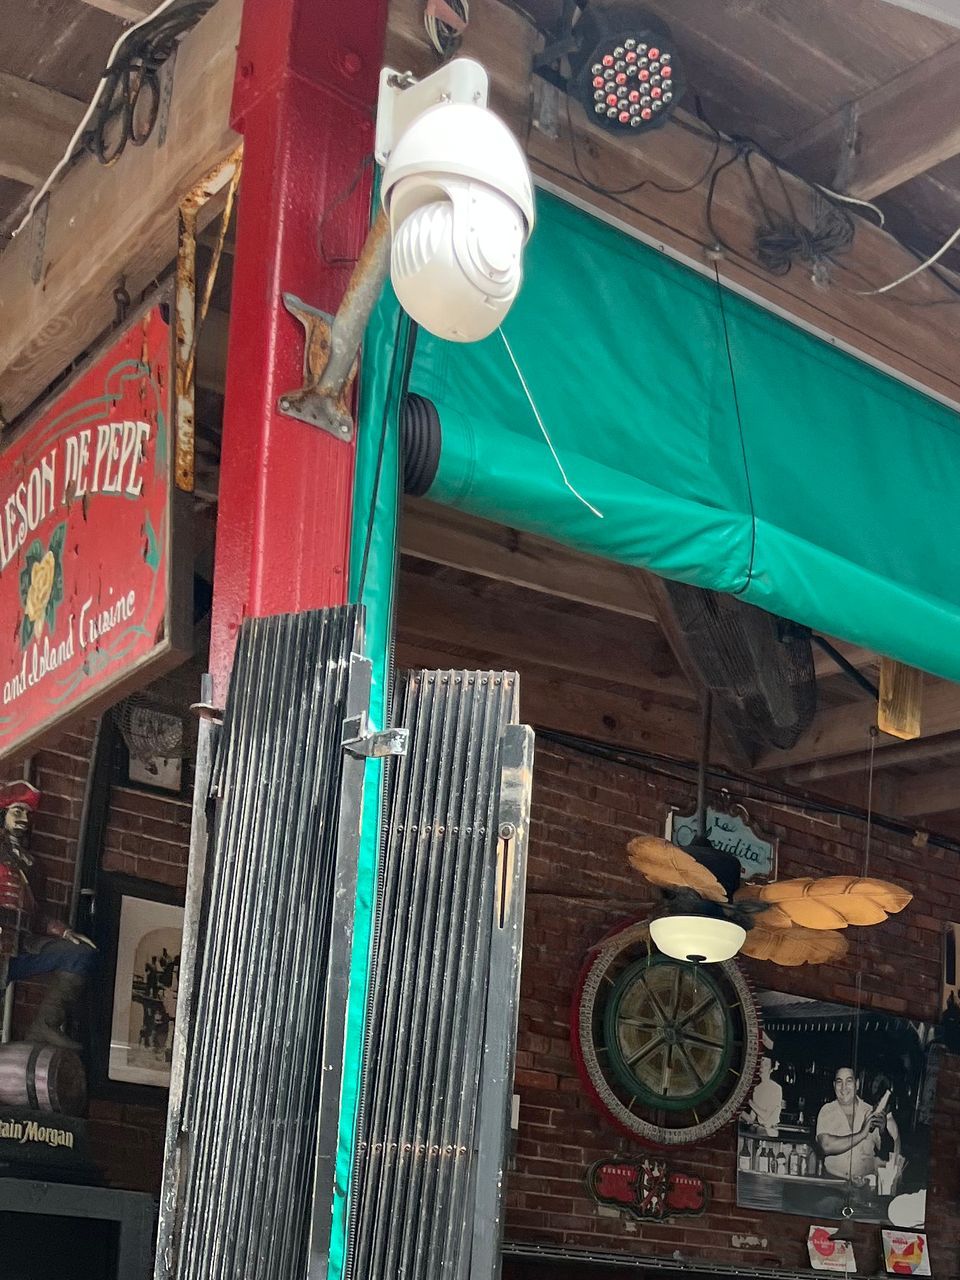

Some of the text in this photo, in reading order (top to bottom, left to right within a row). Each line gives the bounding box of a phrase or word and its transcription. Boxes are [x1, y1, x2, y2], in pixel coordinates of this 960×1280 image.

[61, 429, 91, 505] DE
[91, 421, 150, 496] PEPE
[3, 587, 136, 705] and Island Cuisine
[713, 816, 737, 833] La
[19, 1120, 74, 1150] Morgan
